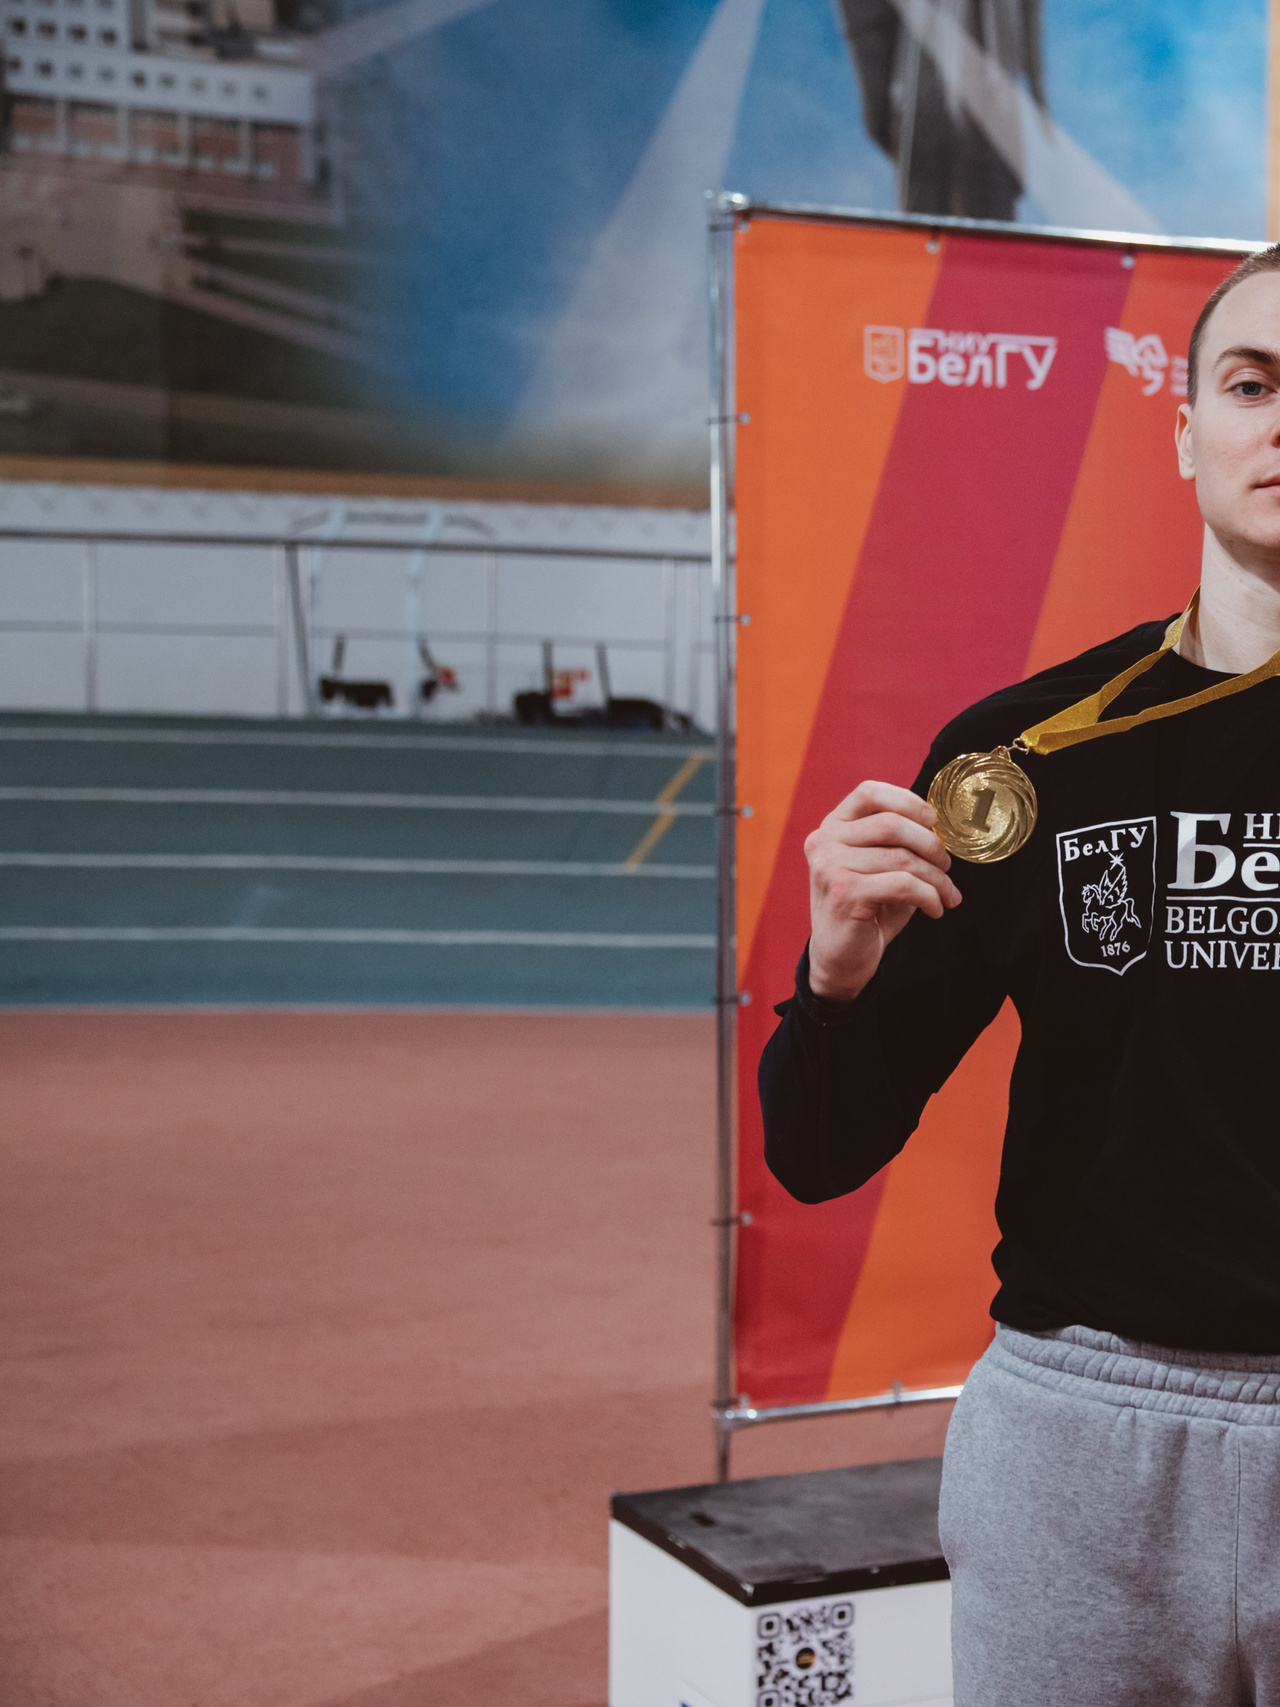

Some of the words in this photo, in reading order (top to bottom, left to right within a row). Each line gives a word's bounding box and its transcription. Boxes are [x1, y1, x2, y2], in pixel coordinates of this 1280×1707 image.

[909, 337, 1058, 390] БелГУ
[961, 787, 996, 833] 1
[1063, 826, 1148, 861] БелГУ
[1100, 941, 1131, 957] 1876
